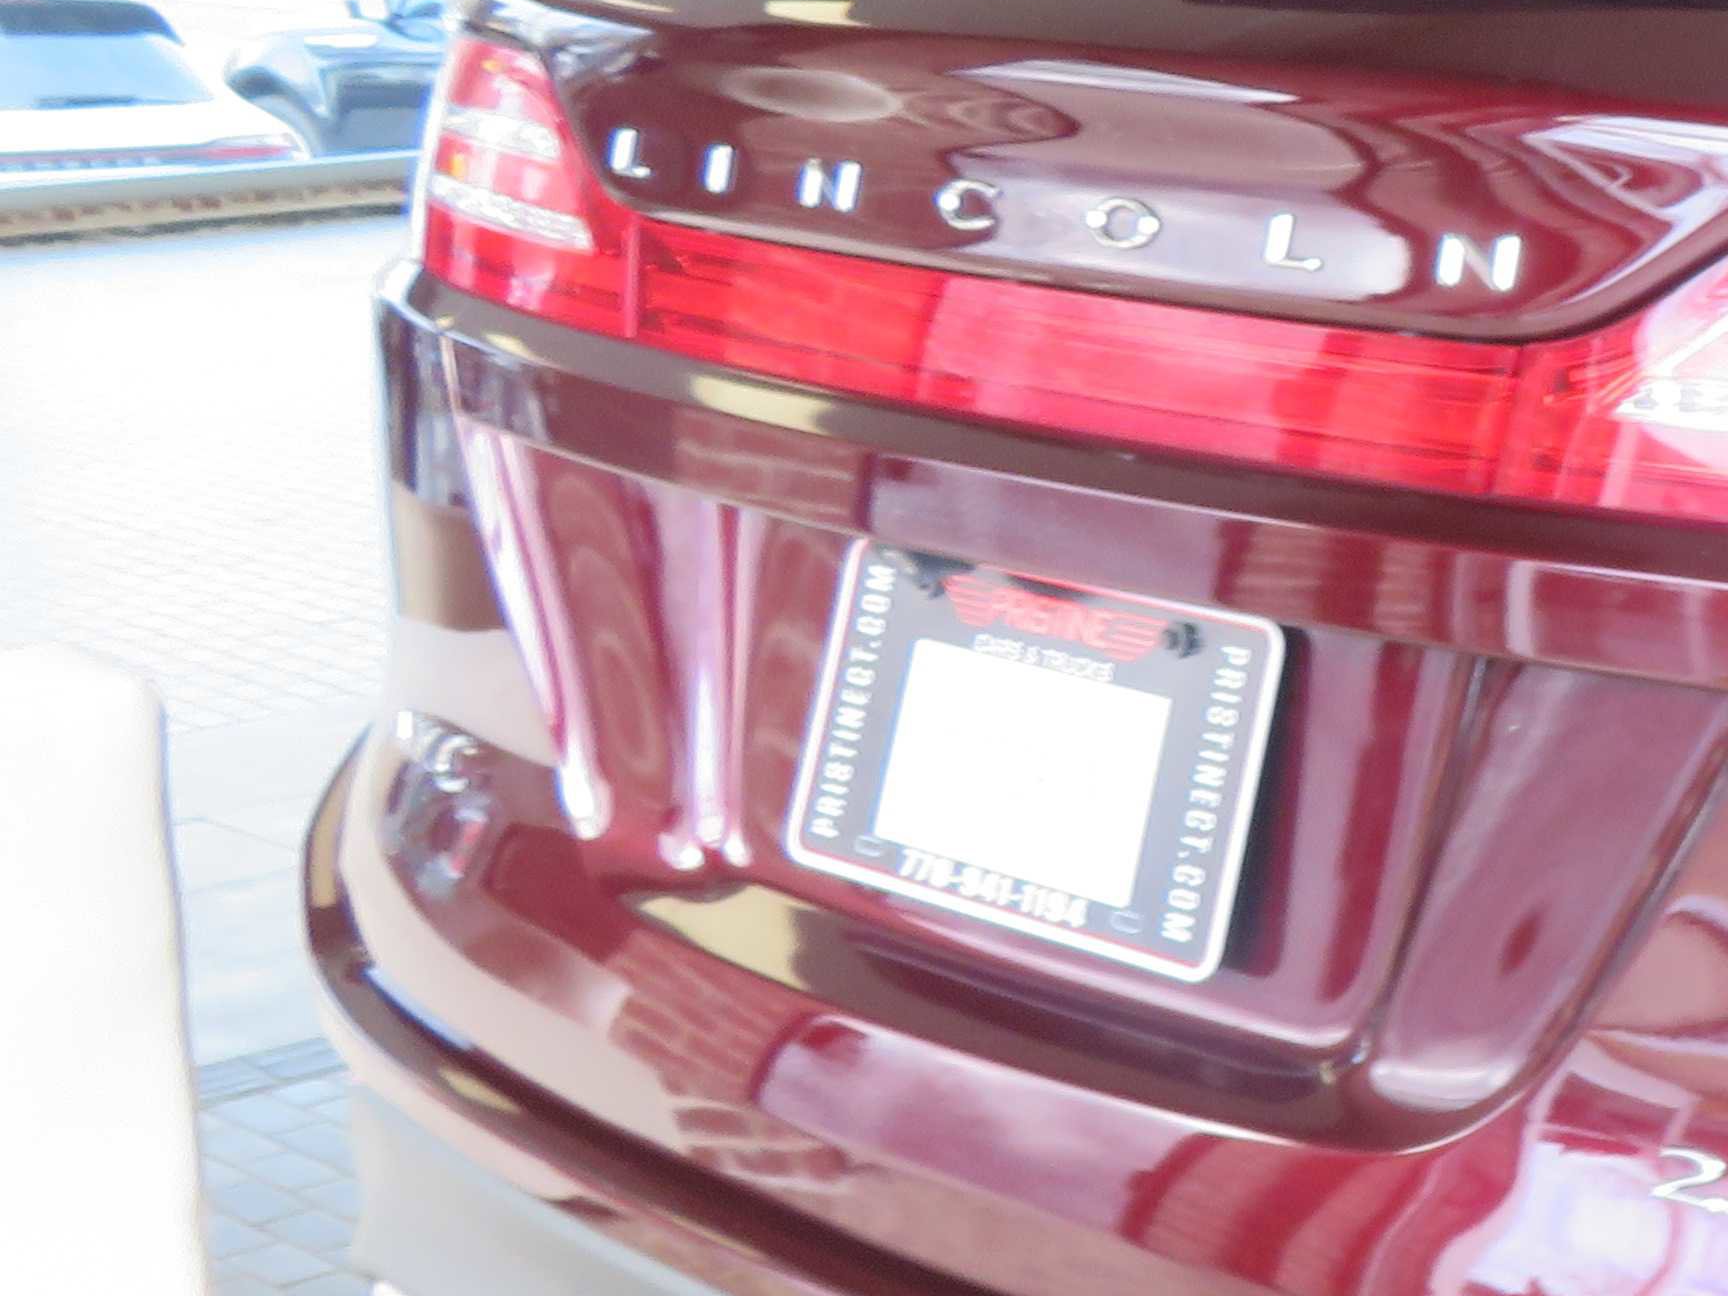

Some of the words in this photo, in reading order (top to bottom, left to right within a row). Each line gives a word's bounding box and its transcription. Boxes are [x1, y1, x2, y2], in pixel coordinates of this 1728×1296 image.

[608, 126, 1521, 292] LINCOLN
[810, 563, 898, 839] PRISTINECT.COM
[1161, 646, 1252, 943] PRISTINECT.COM
